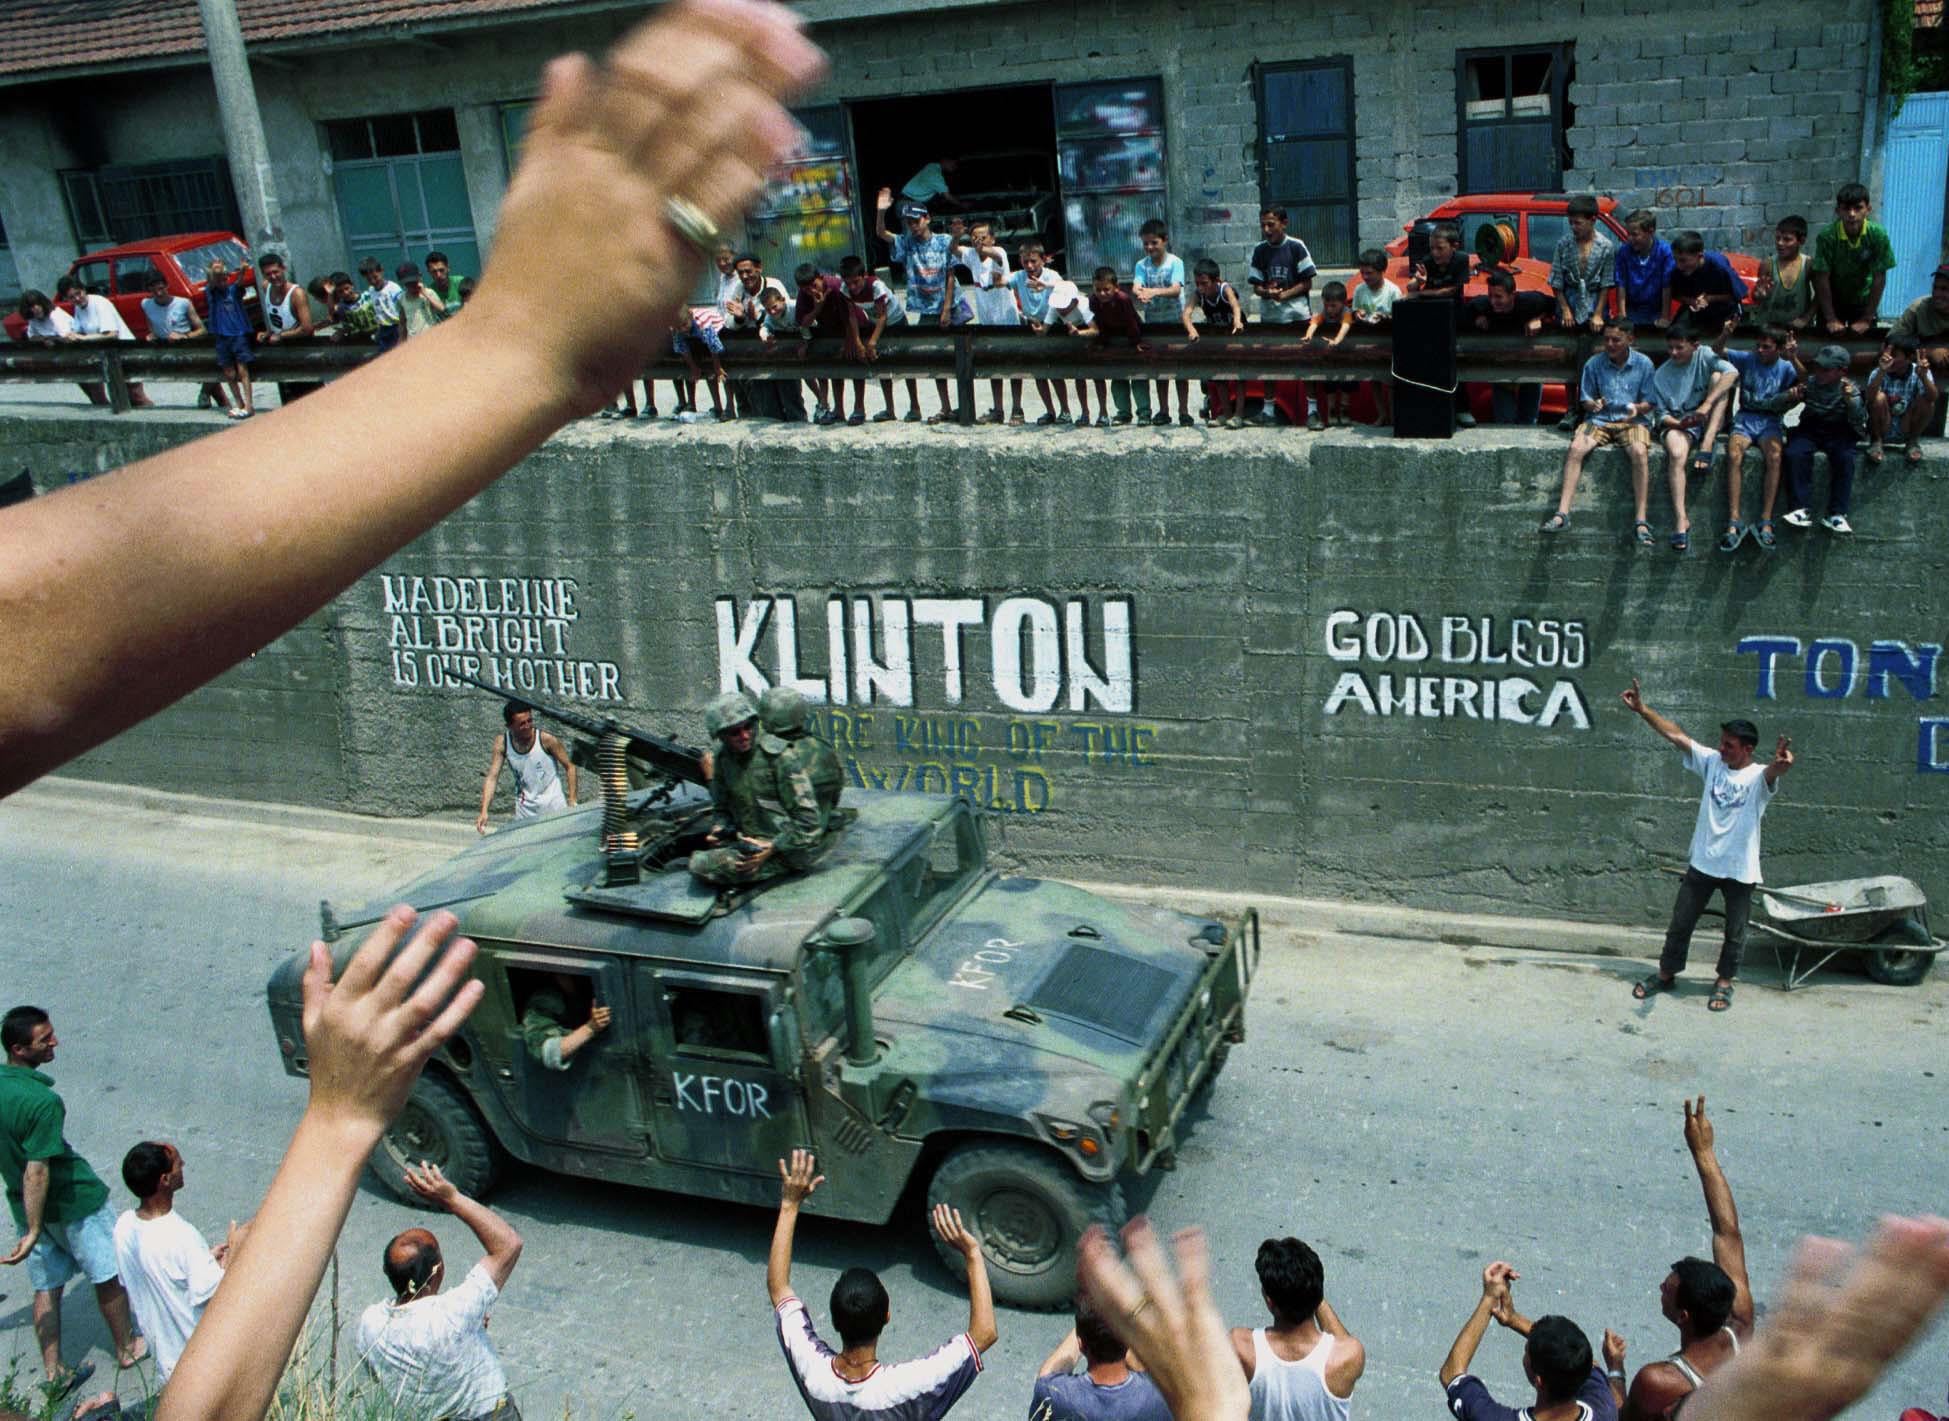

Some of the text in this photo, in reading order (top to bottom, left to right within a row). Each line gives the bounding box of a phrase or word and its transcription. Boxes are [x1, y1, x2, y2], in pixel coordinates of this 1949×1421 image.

[380, 574, 579, 619] MADELEINE
[388, 614, 571, 655] ALBRIGHT
[714, 594, 1138, 713] KLINTON
[1324, 609, 1588, 668] GOD BLESS
[392, 650, 623, 700] IS OUR MOTHER
[1322, 672, 1592, 730] AMERICA
[895, 714, 981, 762] KING
[1005, 719, 1058, 757] OF
[1070, 721, 1159, 768] THE
[845, 754, 1052, 814] WORLD
[947, 937, 1025, 990] KFOR
[672, 1071, 772, 1121] KFOR
